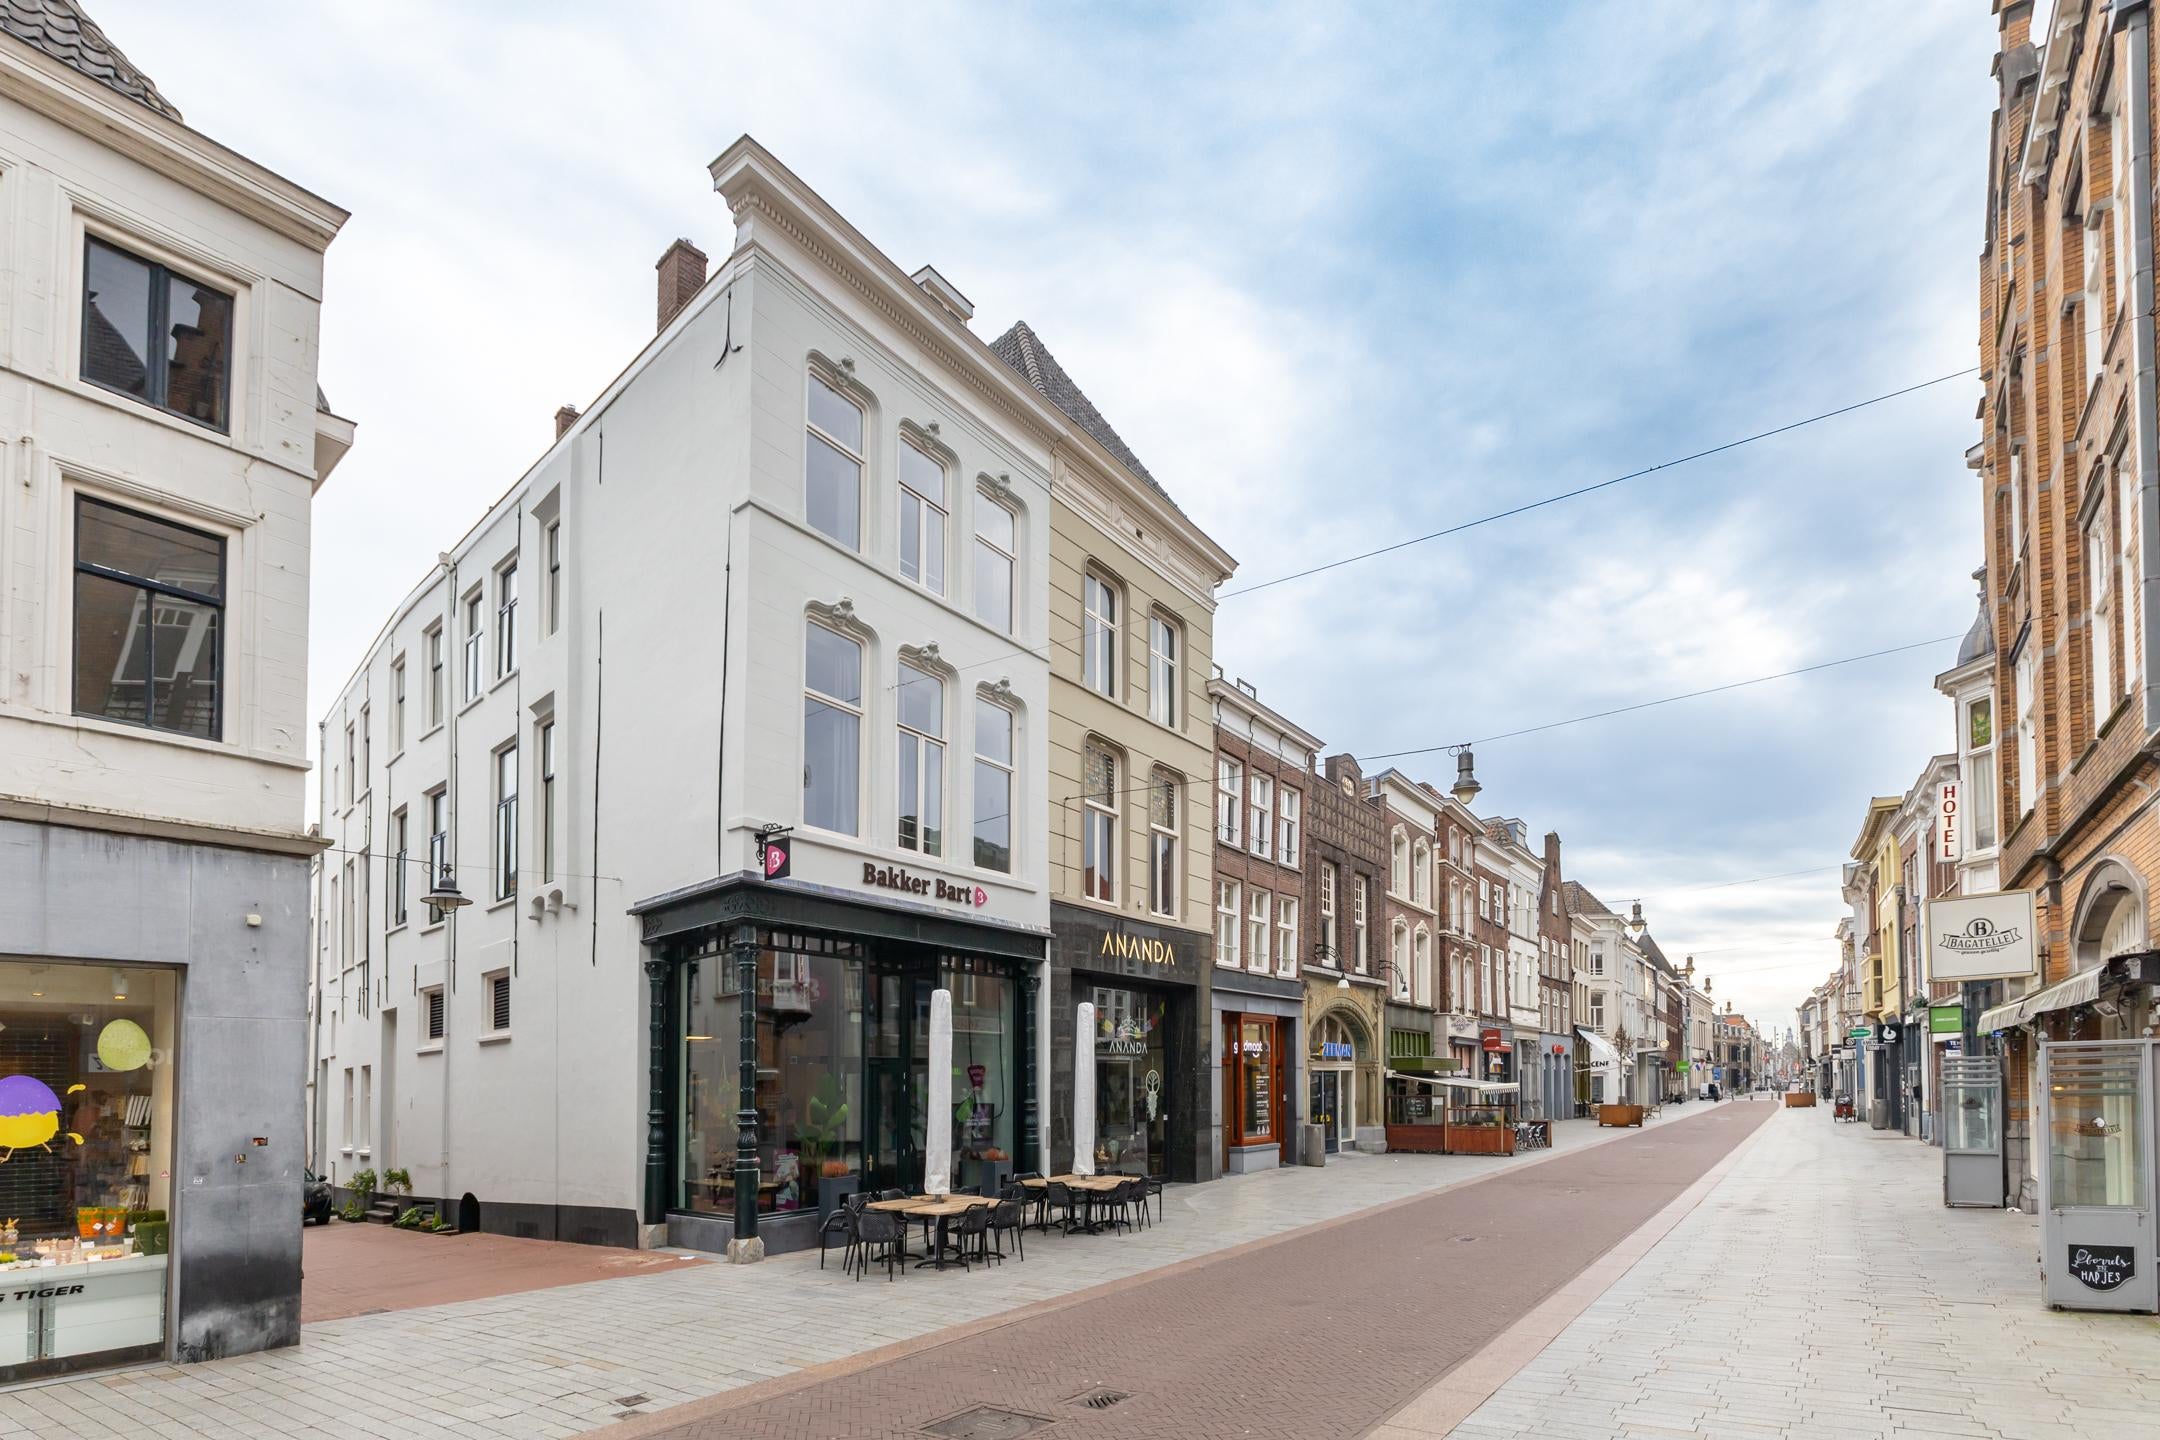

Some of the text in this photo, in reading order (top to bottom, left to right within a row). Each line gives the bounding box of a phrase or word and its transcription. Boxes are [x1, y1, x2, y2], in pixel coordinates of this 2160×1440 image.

[1943, 785, 1956, 857] HOTEL
[862, 862, 972, 904] Bakker Bart
[1974, 921, 1987, 936] B
[1101, 931, 1175, 966] ANANDA
[1949, 934, 2011, 948] BAGATELLE
[1109, 1040, 1148, 1054] ANANDA
[2081, 1271, 2120, 1284] HAPJES
[14, 1285, 85, 1301] TIGER
